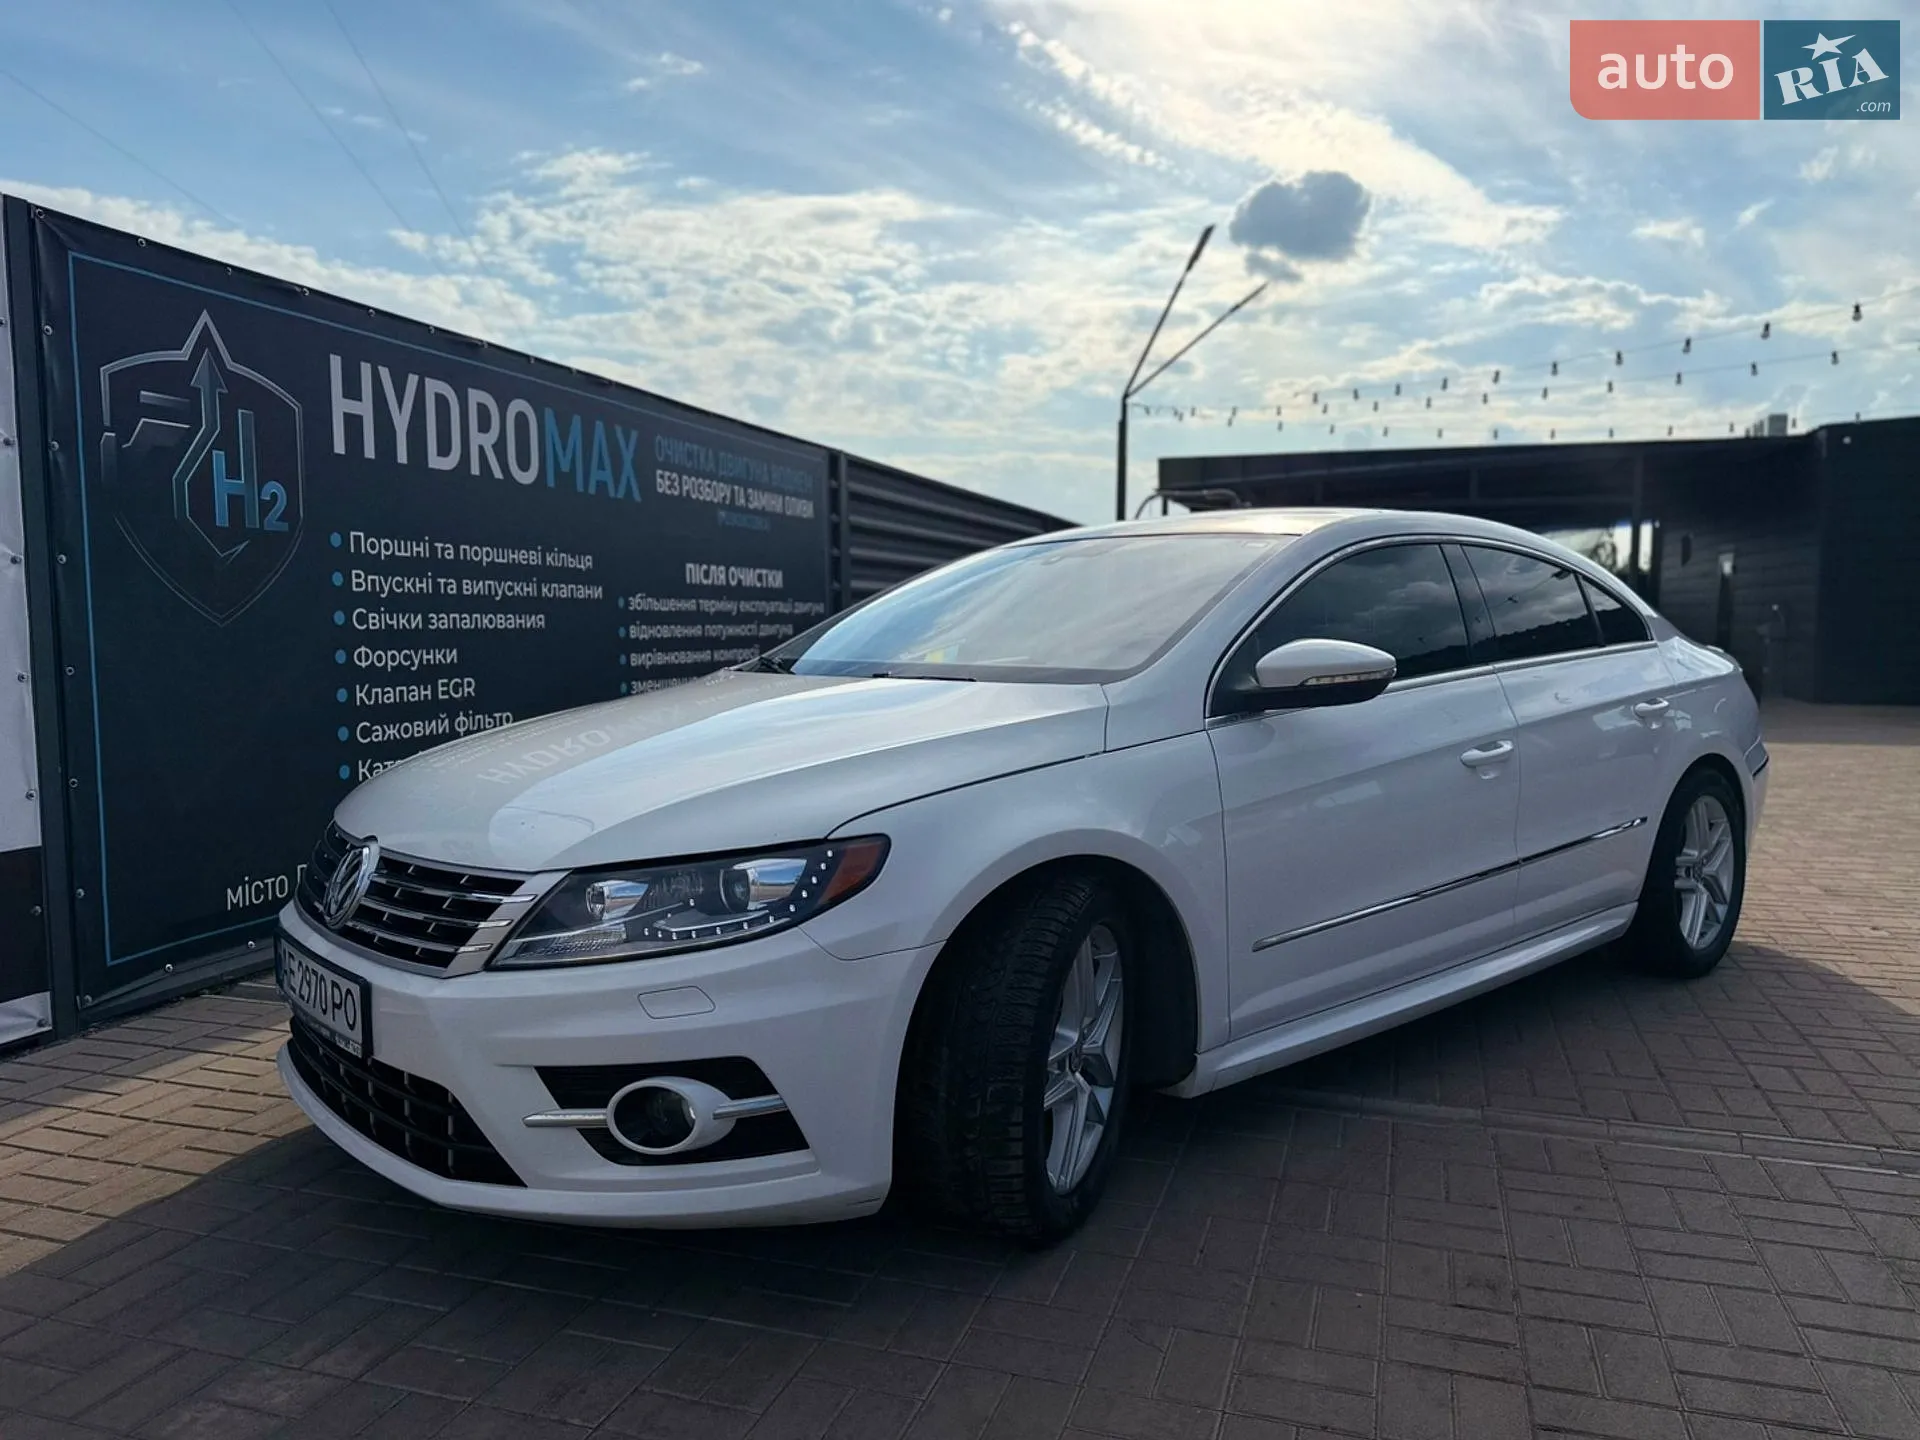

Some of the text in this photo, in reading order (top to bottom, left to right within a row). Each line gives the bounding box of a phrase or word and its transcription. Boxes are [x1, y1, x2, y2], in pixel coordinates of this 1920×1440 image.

[329, 353, 642, 502] HYDROMAX
[655, 435, 716, 473] ОЧИСТКА
[656, 469, 680, 495] БЕЗ
[683, 476, 732, 505] РОЗБОРУ
[733, 486, 747, 507] ТА
[350, 531, 593, 571] Поршні та поршневі кільця
[351, 569, 603, 600] Впускні та випускні клапани
[685, 562, 783, 589] ПІСЛЯ ОЧИСТКИ
[352, 607, 423, 630] Свічки
[628, 593, 696, 612] збільшення
[699, 597, 738, 616] терміну
[629, 620, 702, 641] відновлення
[353, 645, 458, 672] Форсунки
[630, 649, 711, 669] вирівнювання
[356, 677, 475, 706] Клапан EGR
[356, 714, 449, 743] Сажовий
[299, 960, 327, 1016] 2970
[331, 979, 357, 1031] PO
